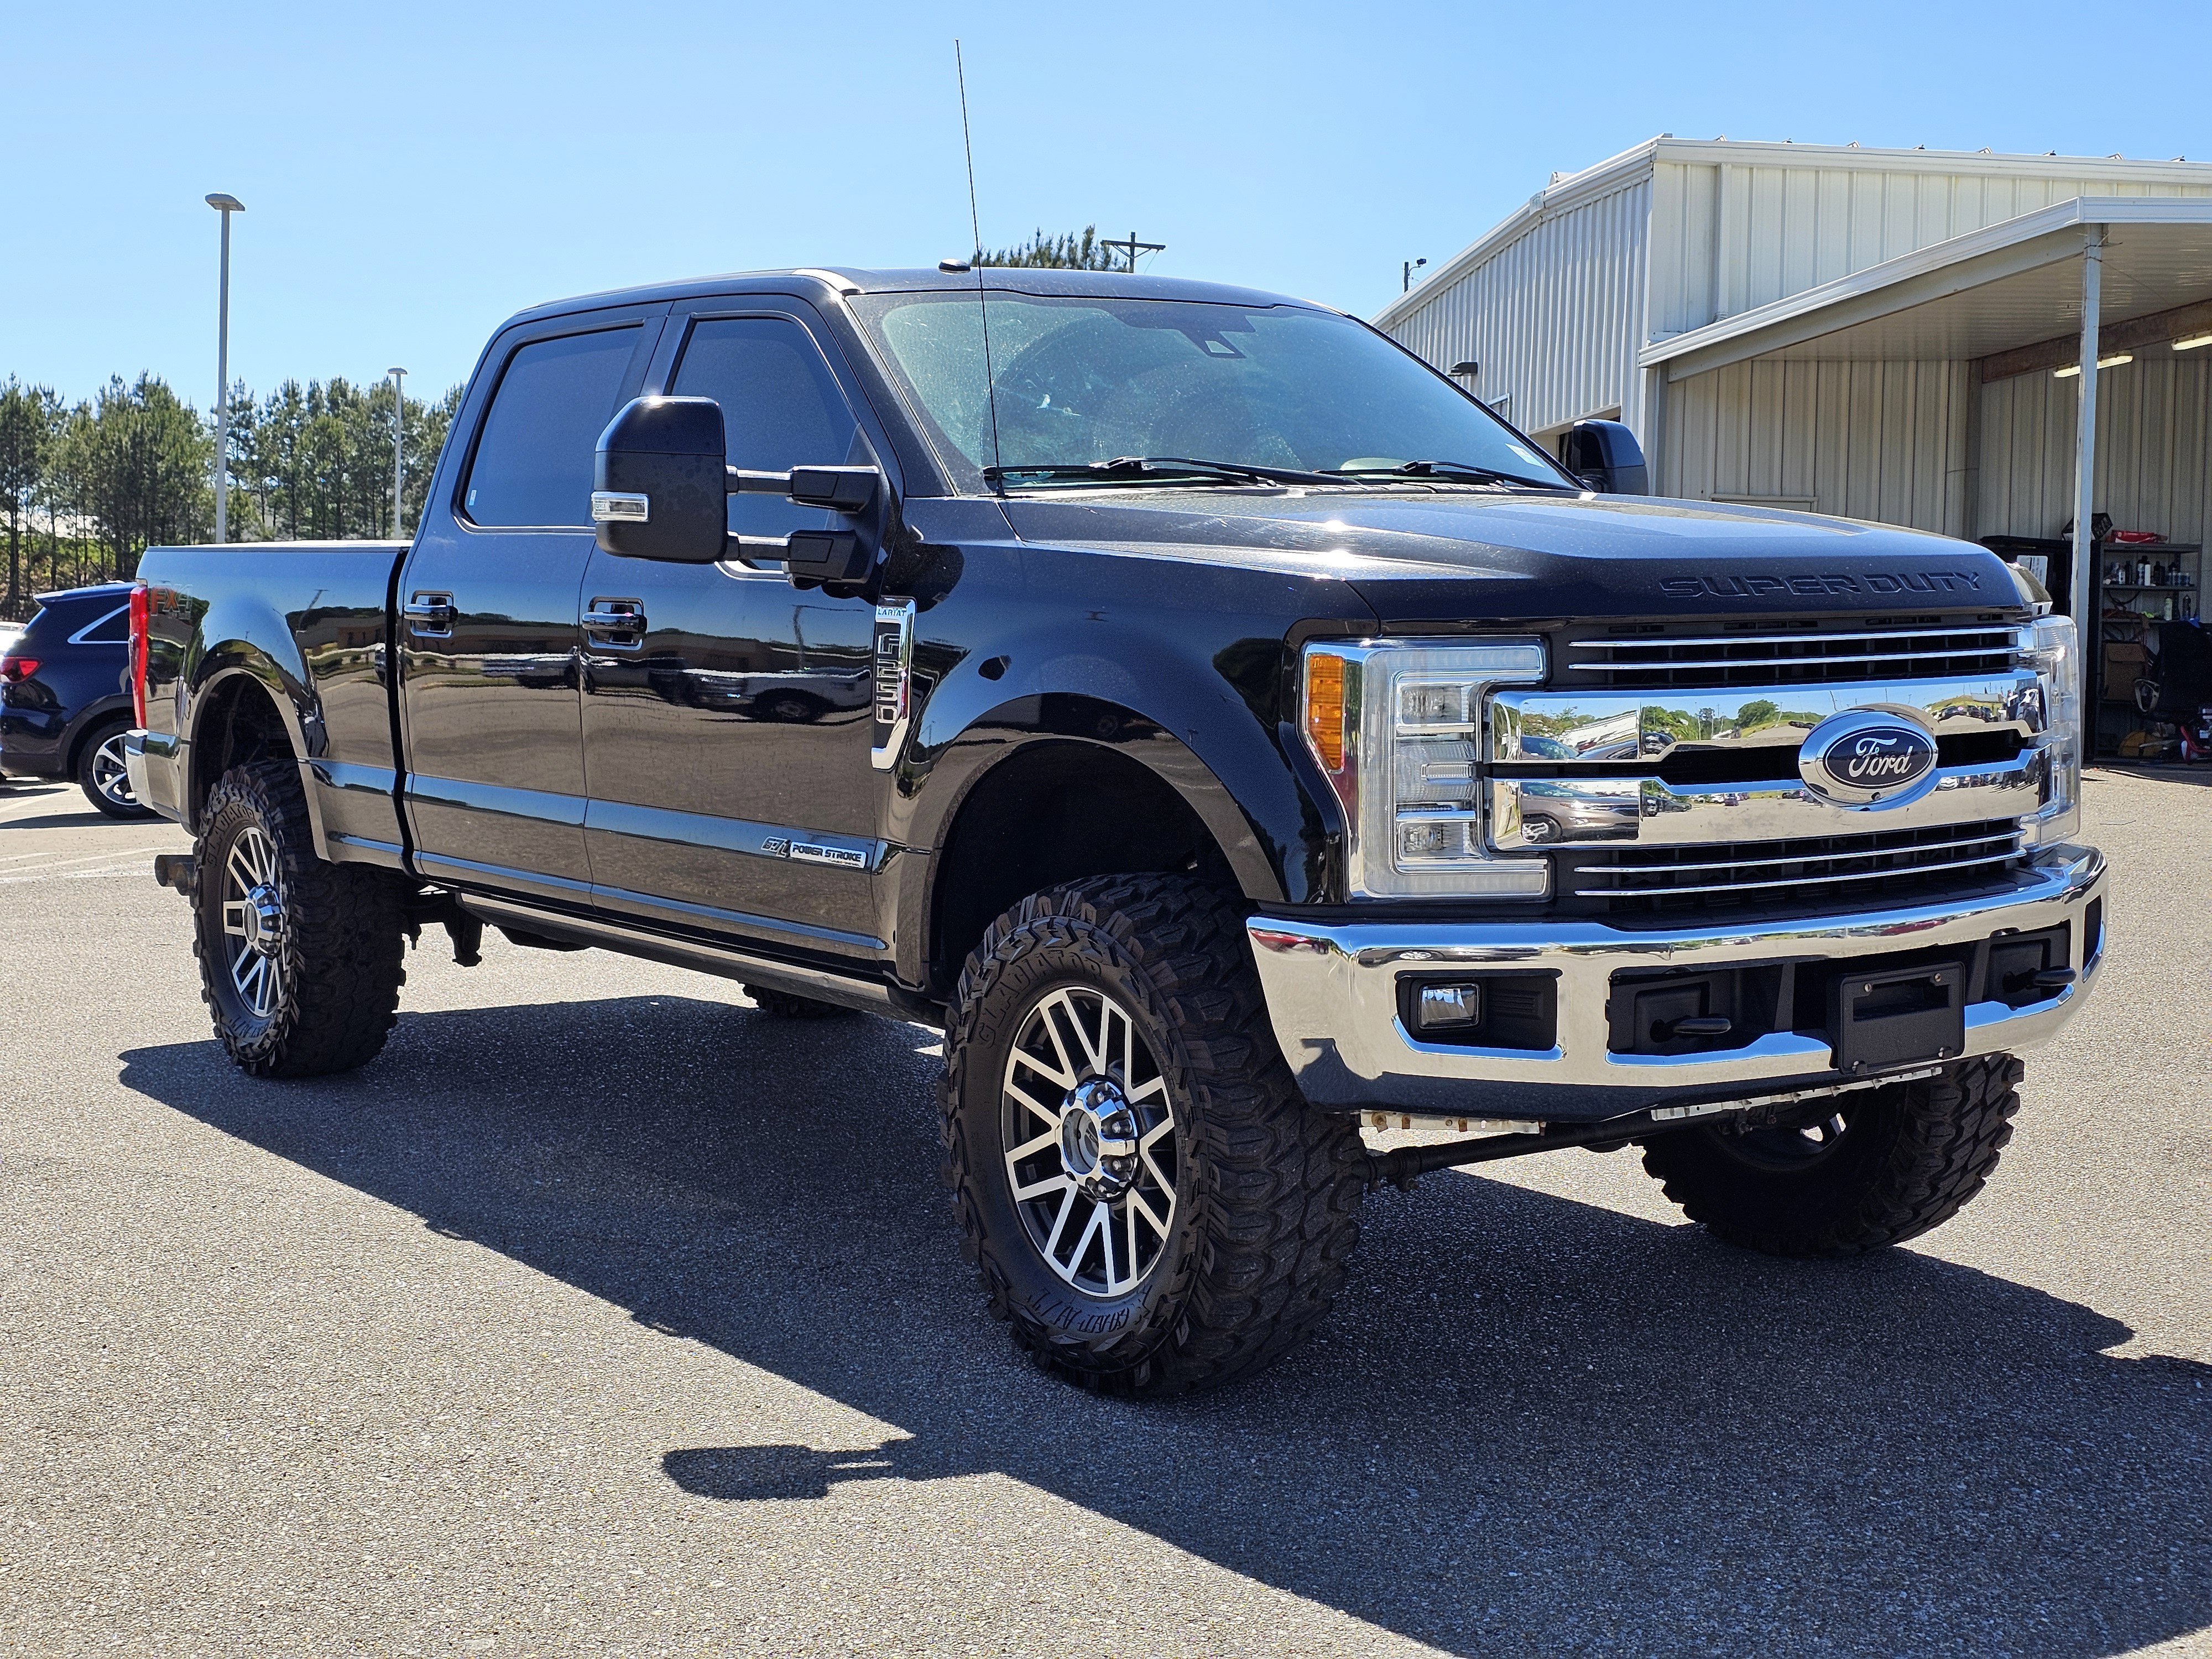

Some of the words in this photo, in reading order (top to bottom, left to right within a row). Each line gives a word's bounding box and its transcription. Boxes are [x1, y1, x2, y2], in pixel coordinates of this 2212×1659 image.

[1659, 575, 1861, 598] SUPER
[1863, 571, 1980, 593] DUTY
[150, 584, 192, 617] FX4
[877, 608, 907, 617] LARIAT
[1848, 737, 1913, 778] Ford
[792, 844, 823, 857] POWER
[825, 849, 862, 862] STROKE
[978, 949, 1102, 1048] GLADIATOR
